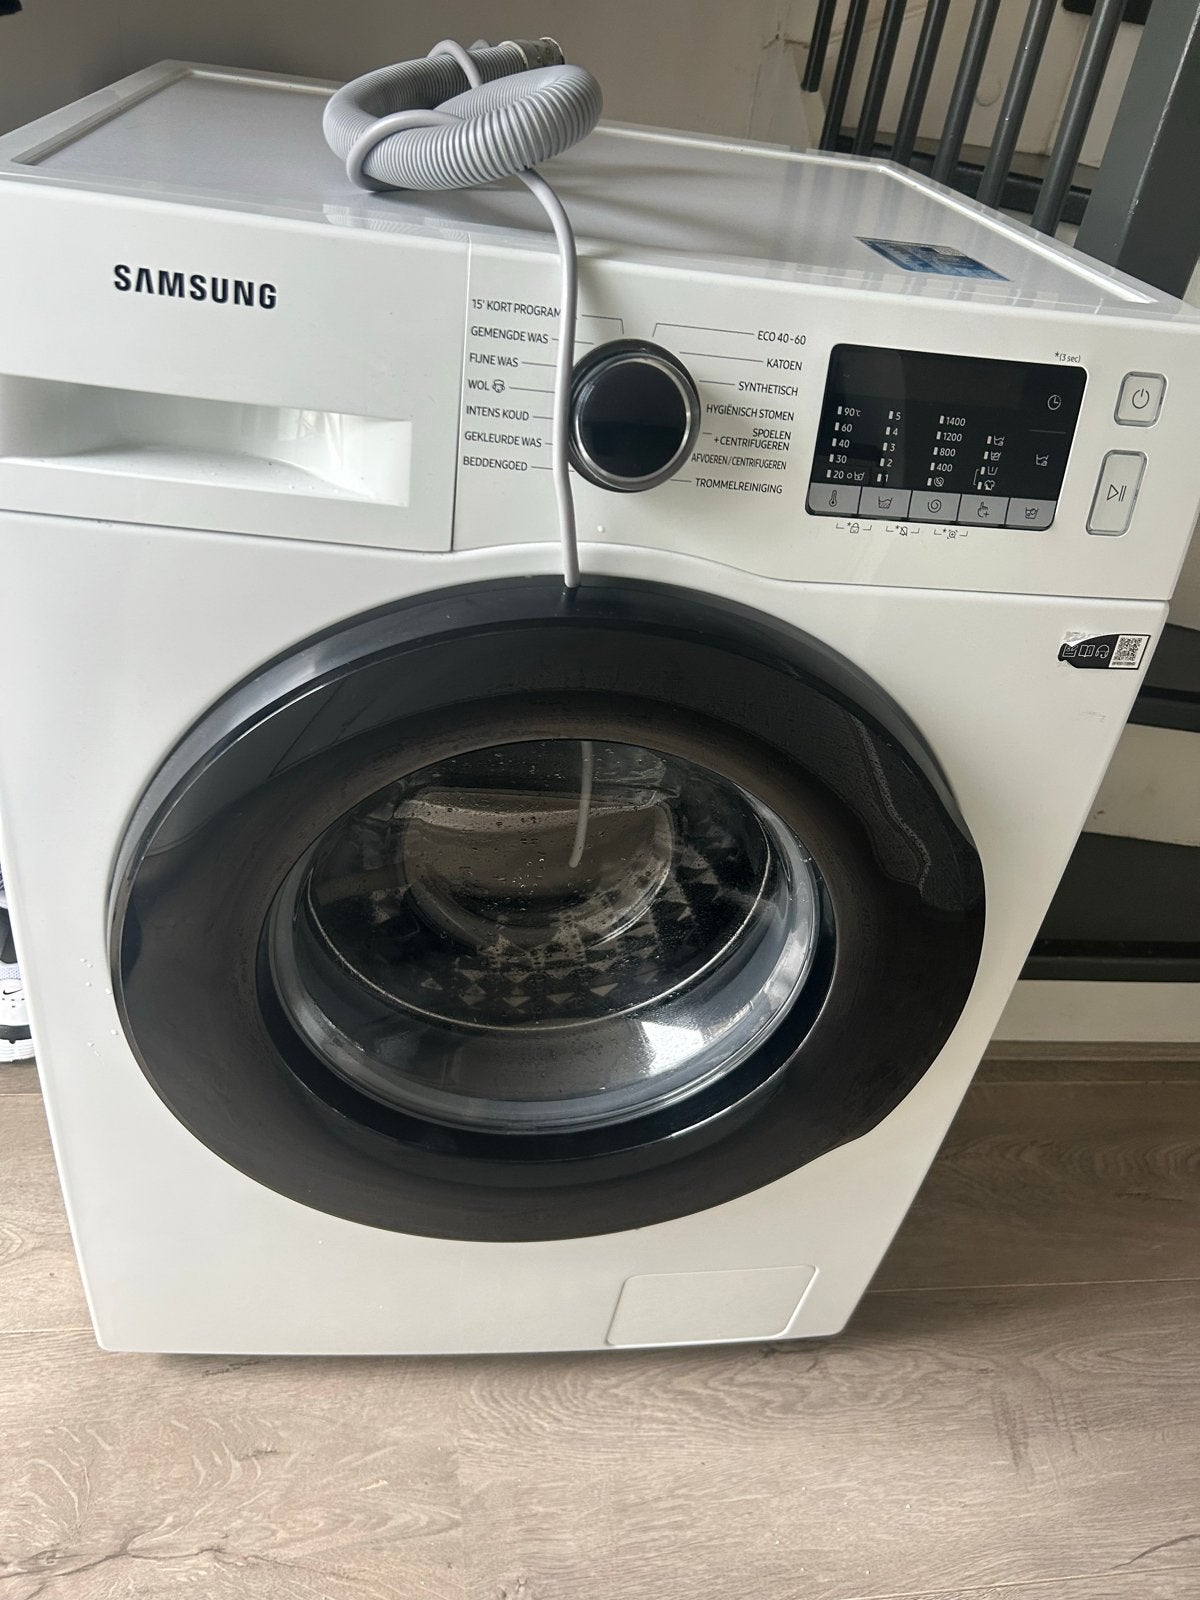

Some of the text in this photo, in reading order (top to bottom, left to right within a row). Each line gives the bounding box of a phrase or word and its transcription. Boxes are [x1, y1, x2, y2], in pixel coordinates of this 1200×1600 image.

[114, 264, 277, 310] SAMSUNG
[487, 300, 512, 313] KORT
[514, 303, 562, 318] PROGRAM
[471, 326, 549, 344] GEMENGDE WAS
[757, 330, 776, 342] ECO
[469, 352, 519, 368] FIJNE WAS
[766, 358, 803, 371] KATOEN
[467, 379, 490, 391] WOL
[738, 381, 799, 396] SYNTHETISCH
[466, 405, 530, 421] INTENS KOUD
[706, 403, 795, 421] HYGIËNISCH STOMEN
[895, 411, 902, 420] 5
[946, 416, 966, 427] 1400
[752, 428, 792, 440] SPOELEN
[841, 423, 853, 433] 60
[892, 427, 898, 436] 4
[464, 430, 542, 448] GEKLEURDE WAS
[943, 432, 963, 442] 1200
[714, 436, 790, 451] +CENTRIFUGEREN
[838, 439, 850, 449] 40
[889, 443, 896, 452] 3
[939, 448, 956, 457] 800
[463, 456, 528, 471] BEDDENGOED
[835, 455, 848, 464] 30
[886, 459, 893, 468] 2
[936, 463, 953, 473] 400
[833, 470, 844, 480] 20
[884, 474, 889, 482] 1
[695, 478, 783, 494] TROMMELREINIGING
